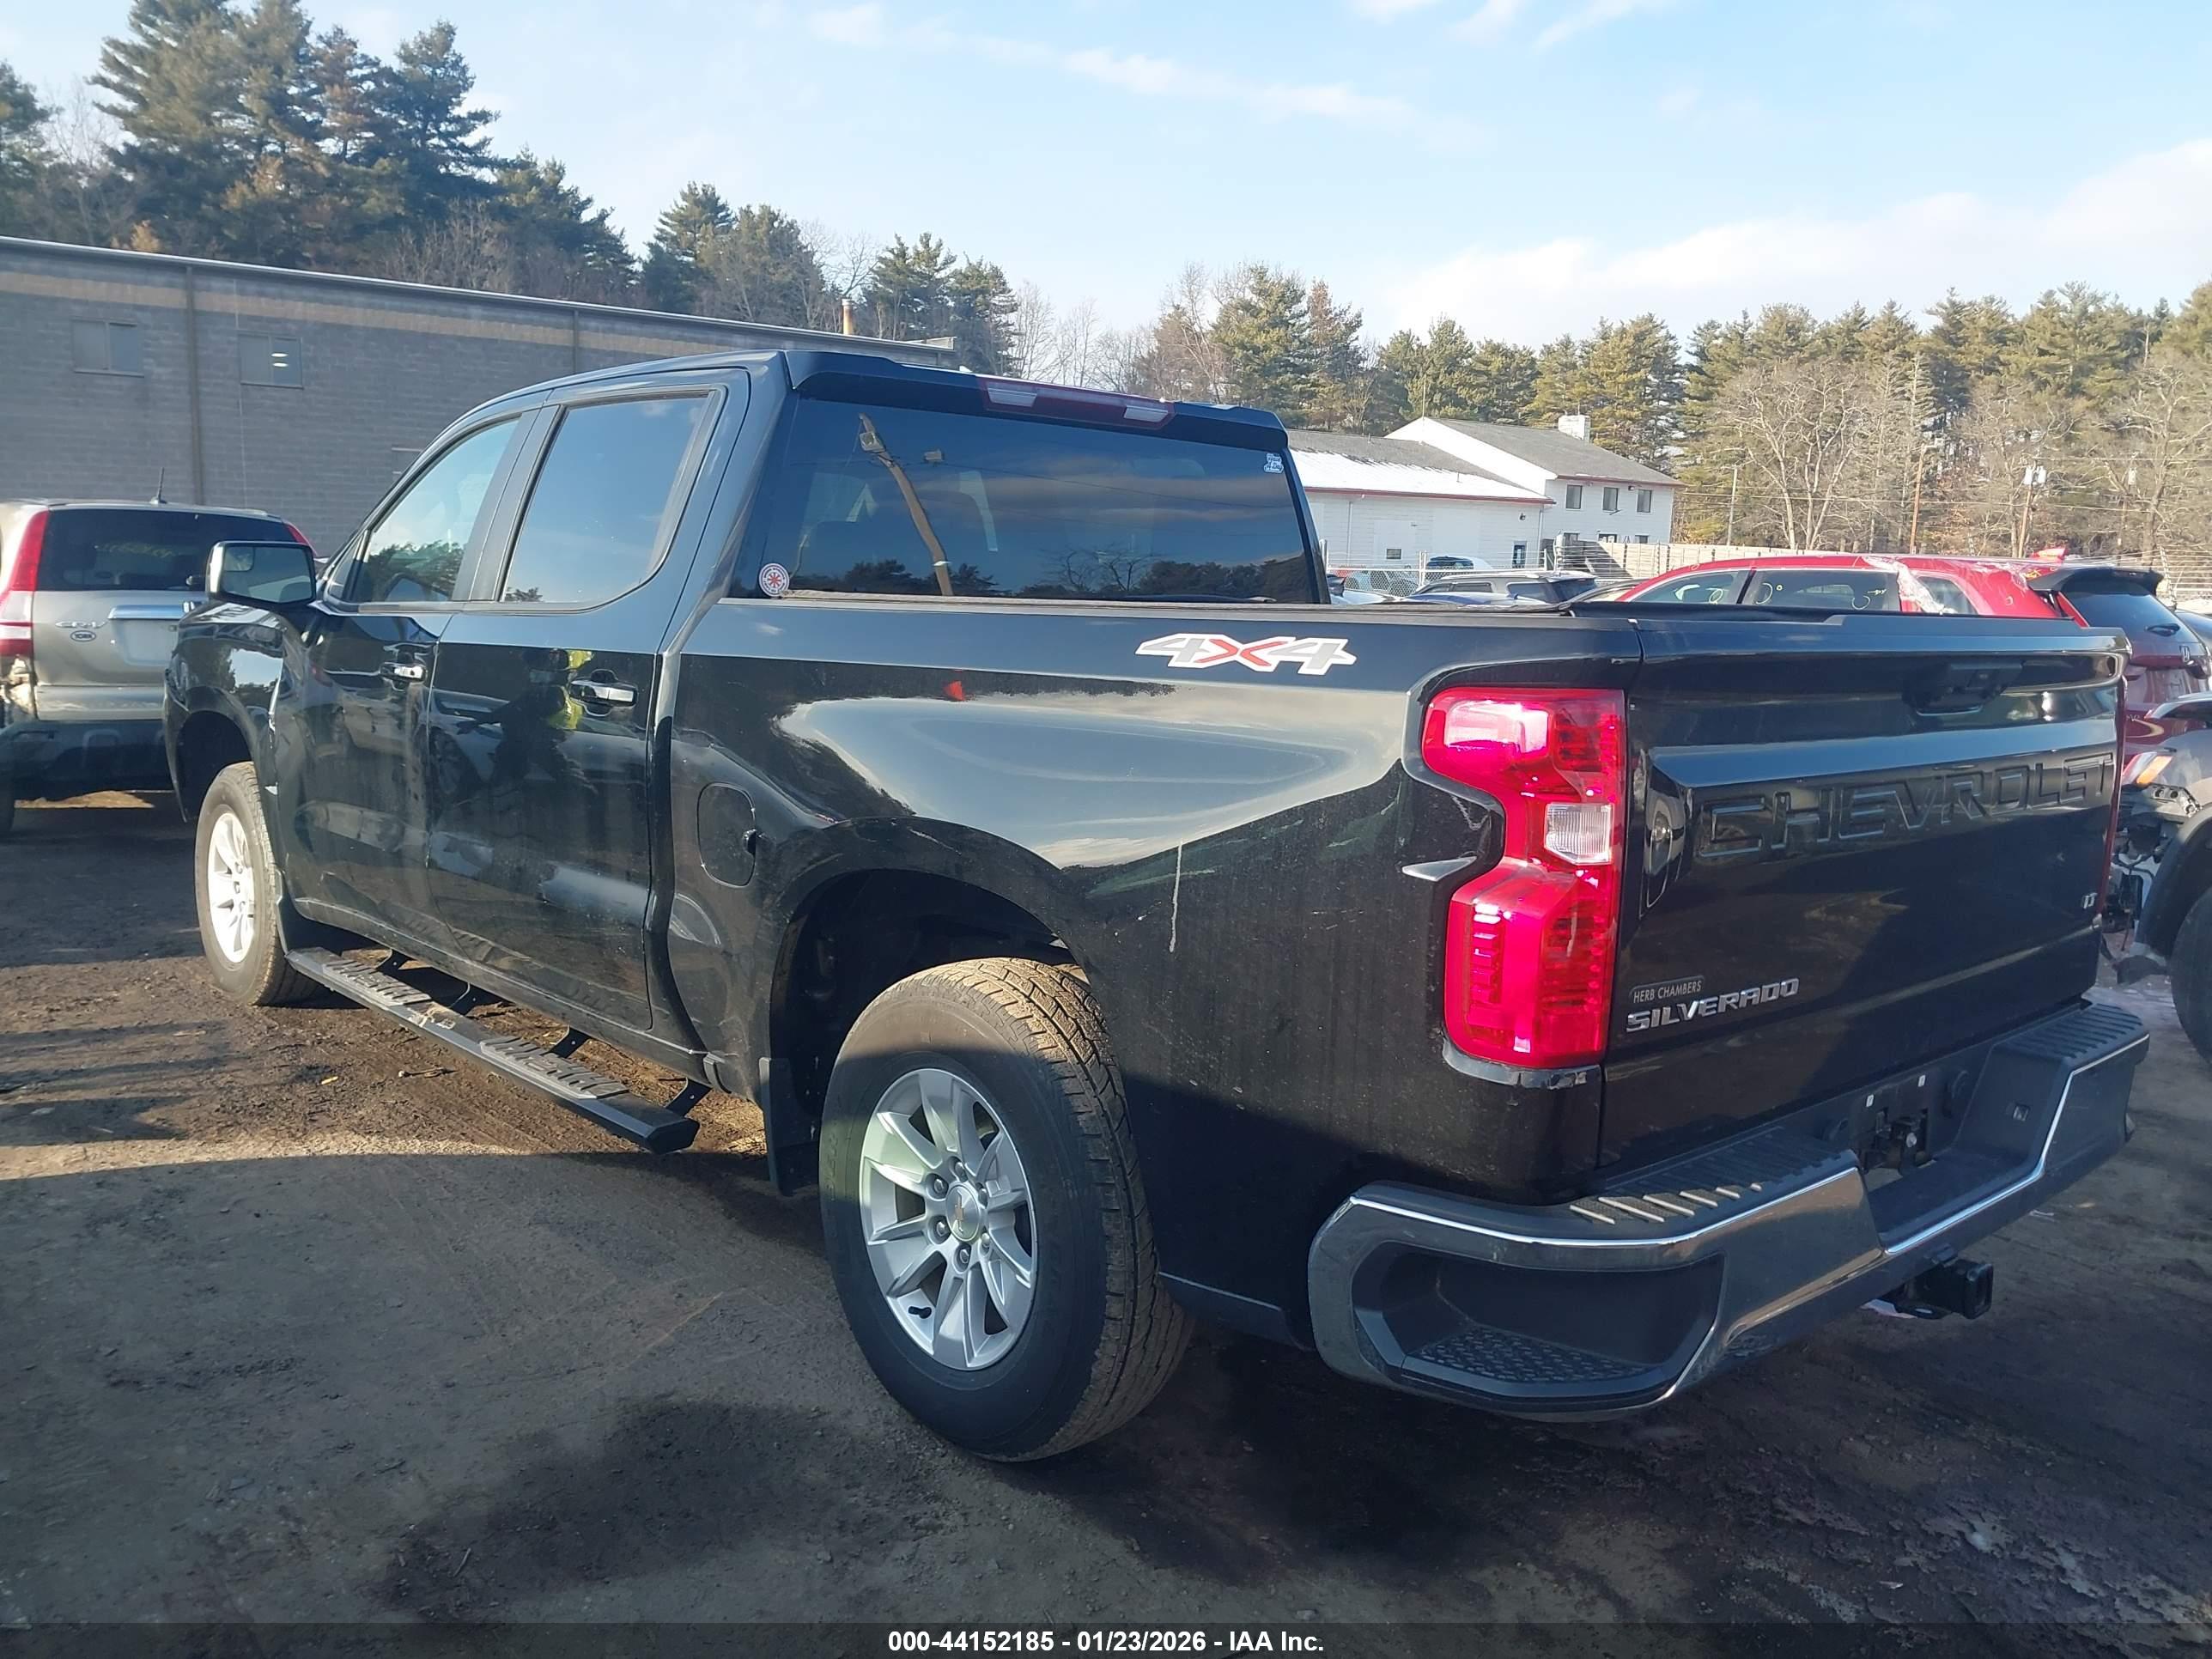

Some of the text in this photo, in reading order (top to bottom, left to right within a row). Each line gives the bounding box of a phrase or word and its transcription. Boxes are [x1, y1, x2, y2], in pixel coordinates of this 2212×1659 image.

[1698, 751, 2114, 858] CHEVROLET
[1626, 977, 1800, 1032] SILVERADO
[1633, 980, 1703, 1004] HERB CHAMBERS
